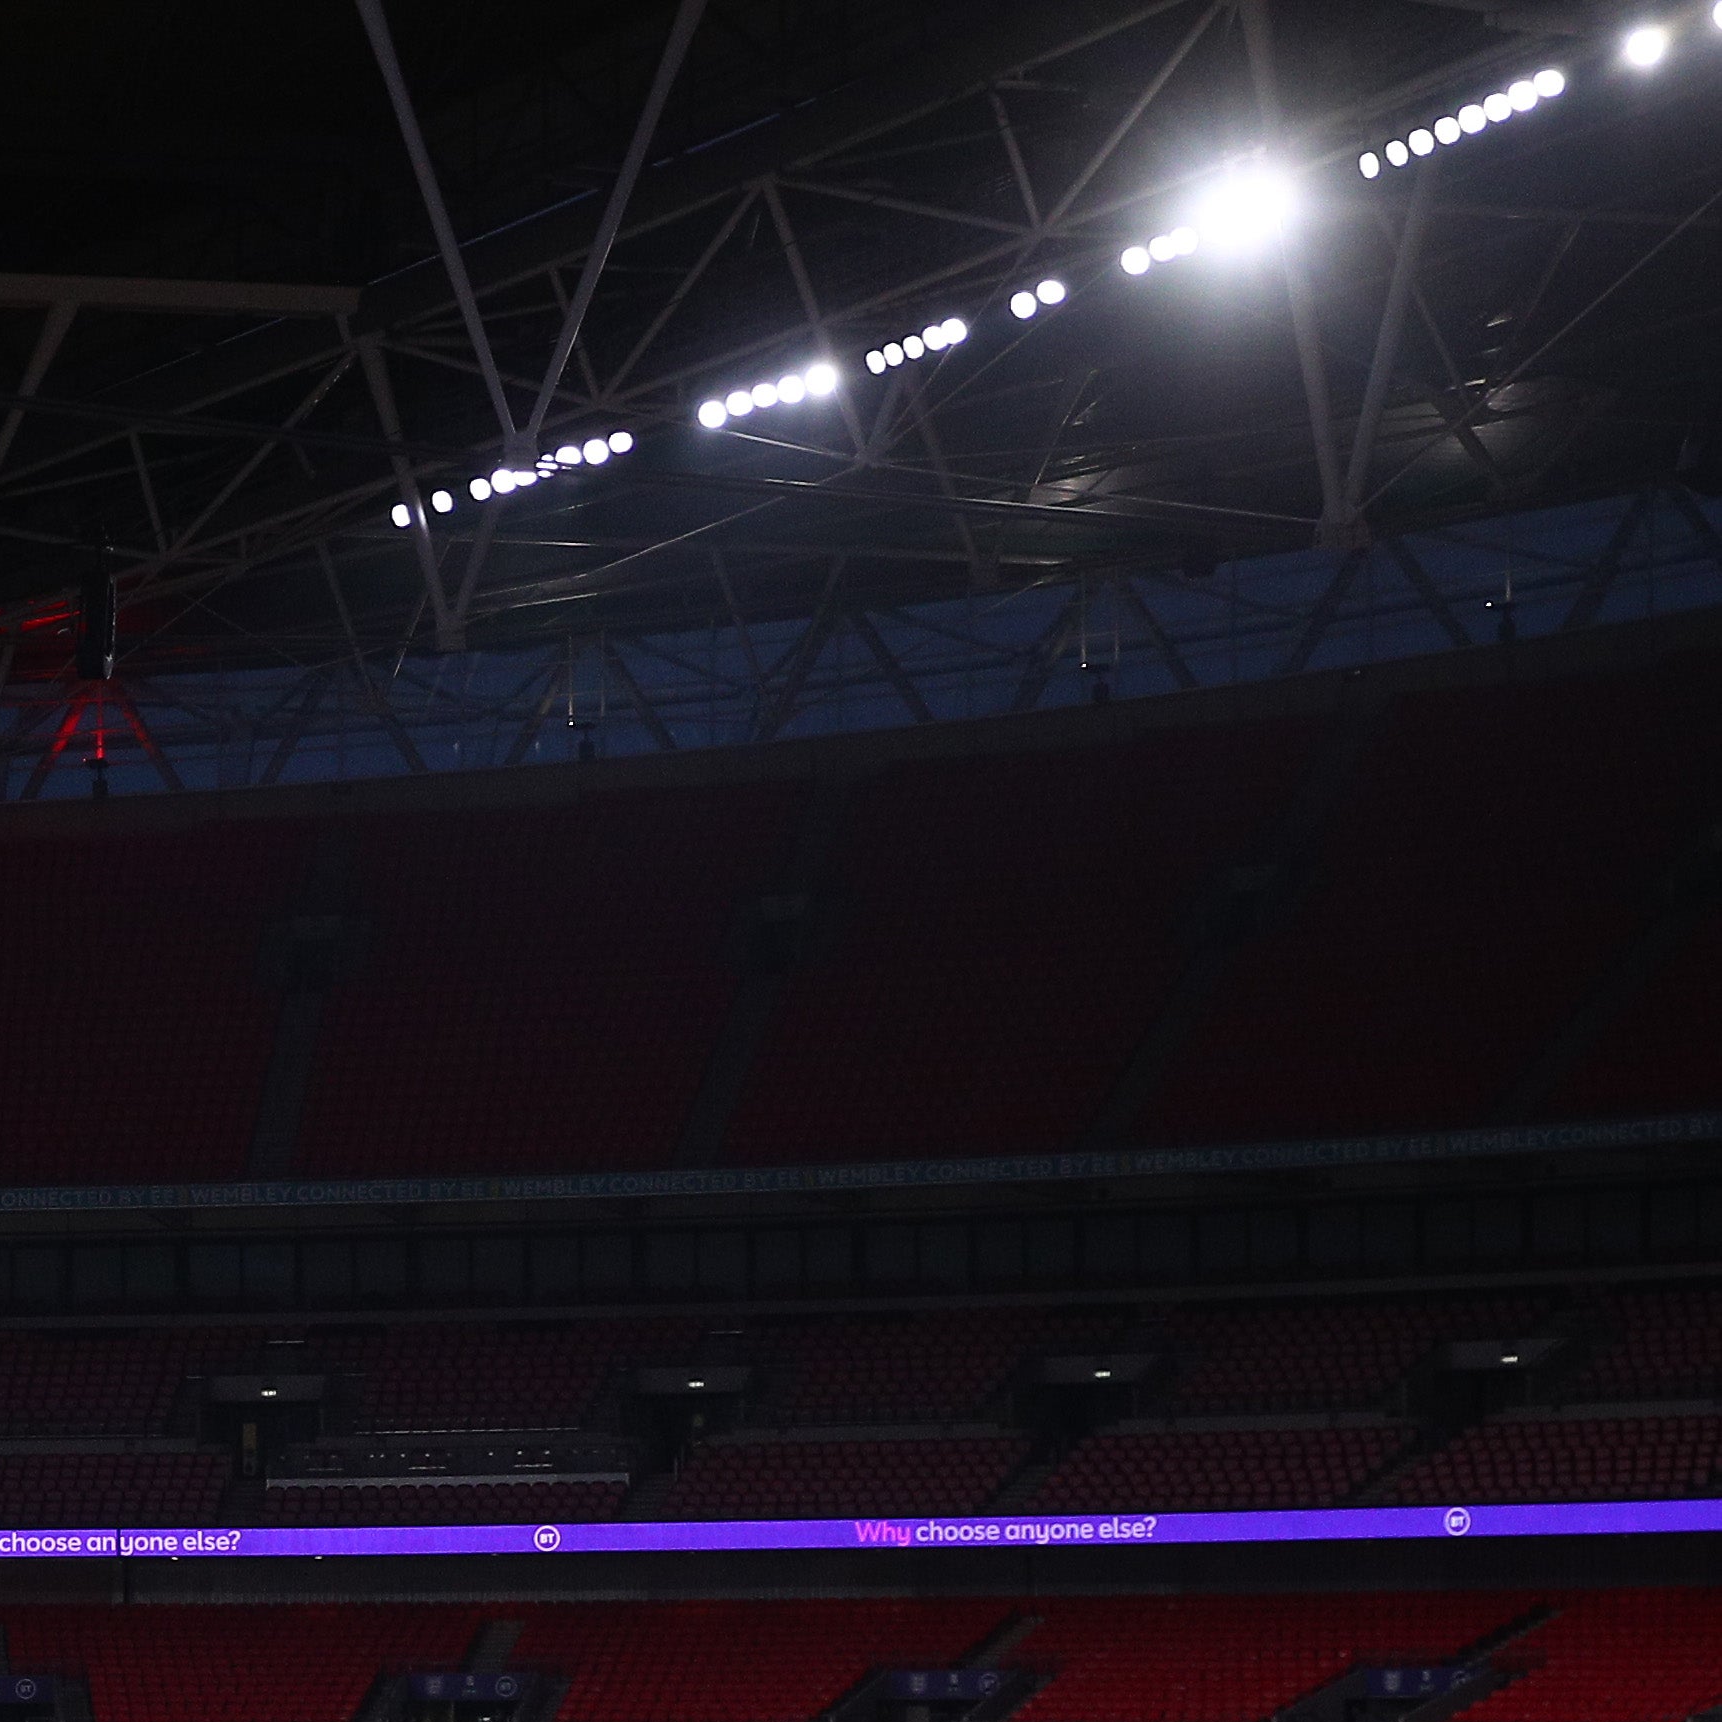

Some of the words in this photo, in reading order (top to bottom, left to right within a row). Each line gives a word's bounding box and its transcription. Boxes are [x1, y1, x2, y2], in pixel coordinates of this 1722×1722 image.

[191, 1185, 292, 1202] WEMBLEY
[297, 1183, 421, 1200] CONNECTED
[429, 1182, 454, 1197] BY
[460, 1182, 484, 1197] EE
[505, 1178, 603, 1196] WEMBLEY
[609, 1174, 738, 1192] CONNECTED
[745, 1172, 771, 1188] BY
[778, 1170, 799, 1186] EE
[119, 1189, 144, 1203] BY
[151, 1188, 174, 1203] EE
[539, 1533, 554, 1544] BT
[855, 1521, 911, 1546] Why
[916, 1521, 1000, 1541] choose
[1005, 1524, 1093, 1545] anyone
[1099, 1517, 1156, 1538] else?
[0, 1532, 81, 1552] choose
[87, 1537, 177, 1558] anyone
[183, 1531, 241, 1551] else?
